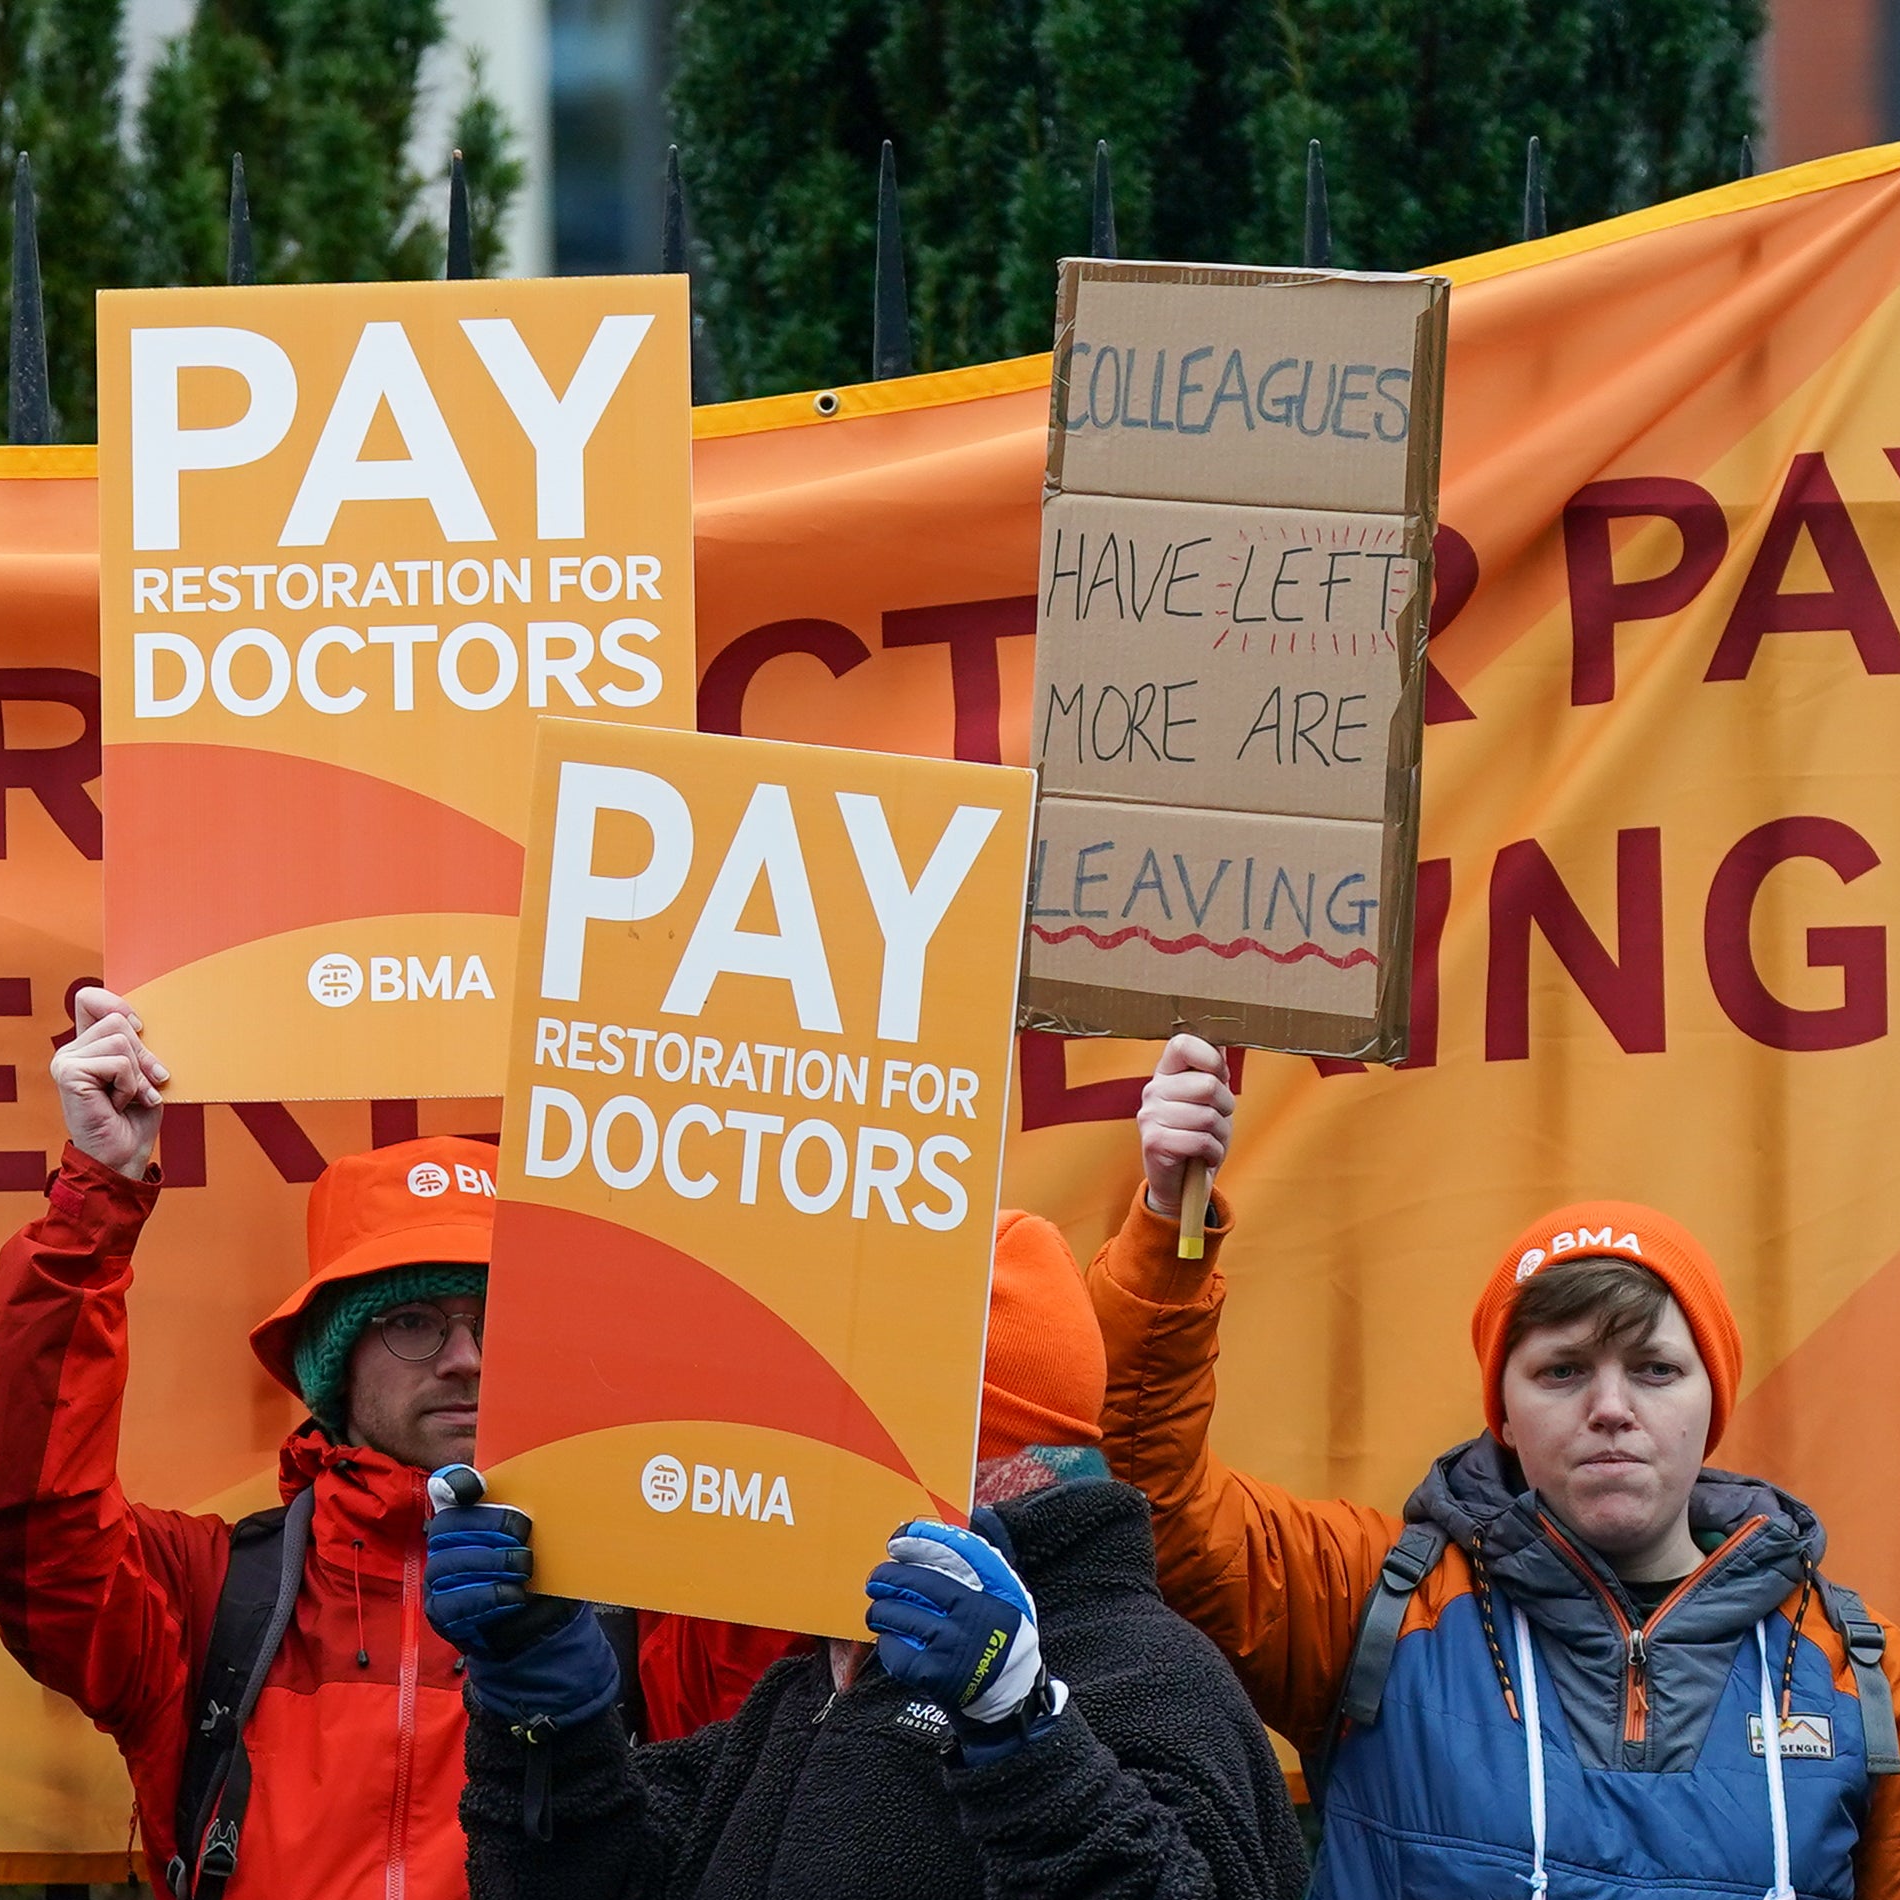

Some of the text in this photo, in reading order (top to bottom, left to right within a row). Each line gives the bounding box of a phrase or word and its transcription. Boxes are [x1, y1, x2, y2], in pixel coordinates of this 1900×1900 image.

[130, 314, 655, 552] PAY
[1059, 339, 1414, 445] COLLEAGUES
[132, 553, 662, 614] RESTORATION FOR
[1046, 528, 1420, 633] HAVE LEFT
[134, 618, 663, 719] DOCTORS
[1041, 679, 1199, 768] MORE
[1237, 686, 1369, 769] ARE
[540, 761, 1002, 1043] PAY
[1031, 838, 1380, 940] LEAVING
[369, 953, 496, 1003] BMA
[534, 1017, 979, 1120] RESTORATION FOR
[455, 1163, 498, 1198] BM
[524, 1085, 972, 1233] DOCTORS
[1551, 1226, 1642, 1257] BMA
[690, 1463, 795, 1526] BMA
[1756, 1743, 1828, 1754] PSENGER
